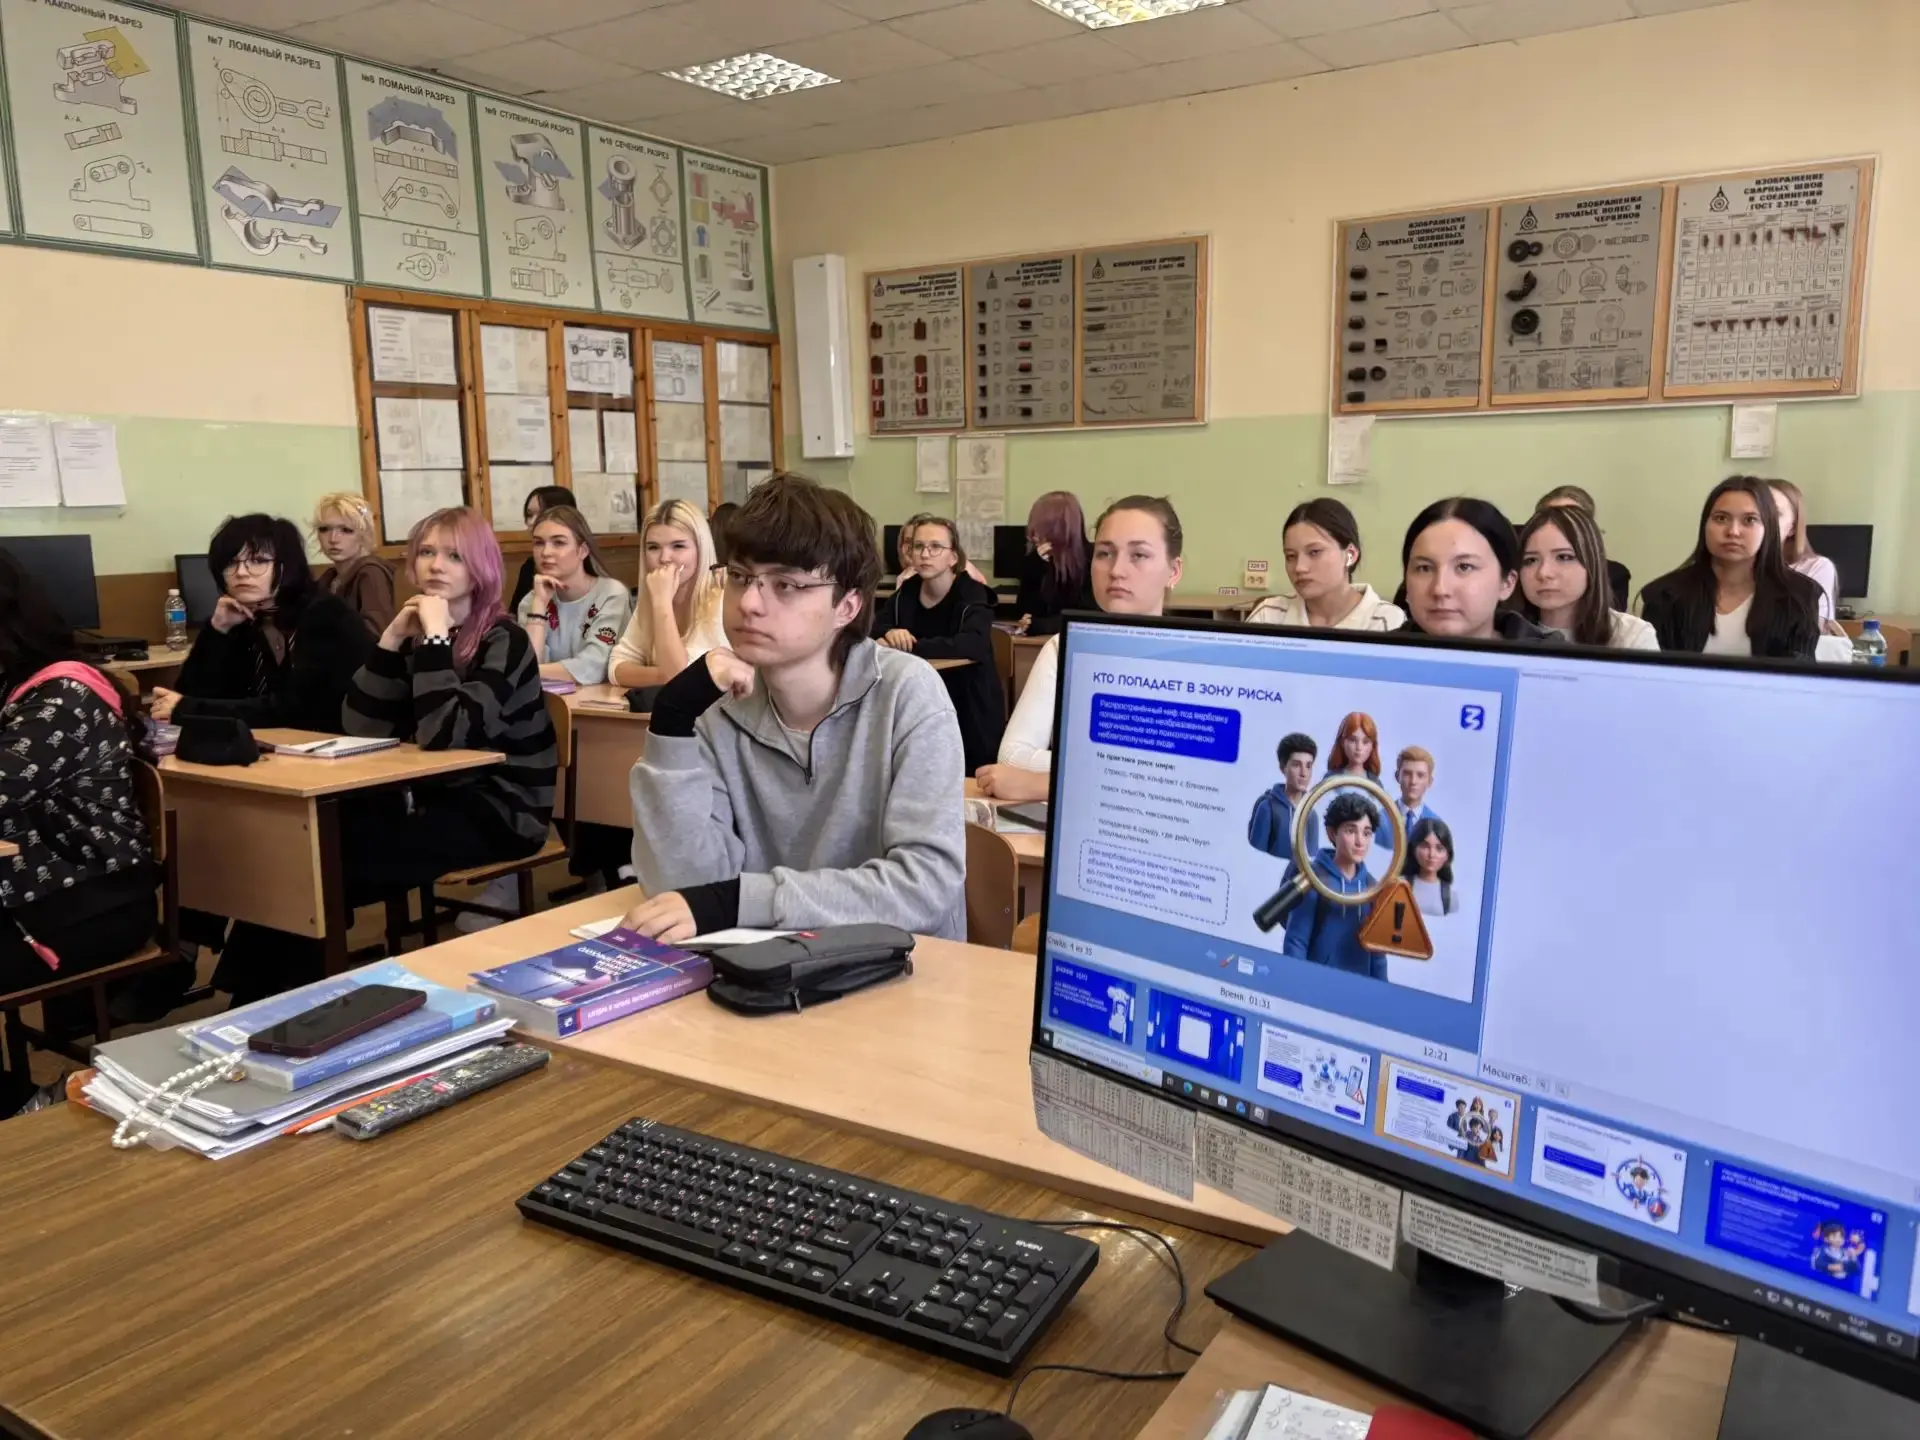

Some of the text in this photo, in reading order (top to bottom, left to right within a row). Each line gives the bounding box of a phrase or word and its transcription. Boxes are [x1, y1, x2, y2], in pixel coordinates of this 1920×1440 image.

[44, 0, 143, 29] НАКЛОННЫЙ РАЗРЕЗ
[207, 34, 321, 69] №7 ЛОМАНЫЙ РАЗРЕЗ
[378, 77, 423, 97] ЛОМАНЫЙ
[425, 89, 456, 105] РАЗРЕЗ
[500, 110, 549, 129] СТУПЕНЧАТЫЙ
[550, 123, 575, 136] РАЗРЕЗ
[647, 147, 670, 160] РАЗРЕЗ
[1743, 184, 1790, 195] СВАРНЫХ
[1750, 202, 1772, 210] ГОСТ
[1093, 672, 1283, 702] КТО ПОПАДАЕТ В ЗОНУ РИСКА
[1220, 986, 1271, 1009] Время: 01:31
[1423, 1046, 1448, 1062] 12:21
[1482, 1064, 1531, 1086] Масштаб:
